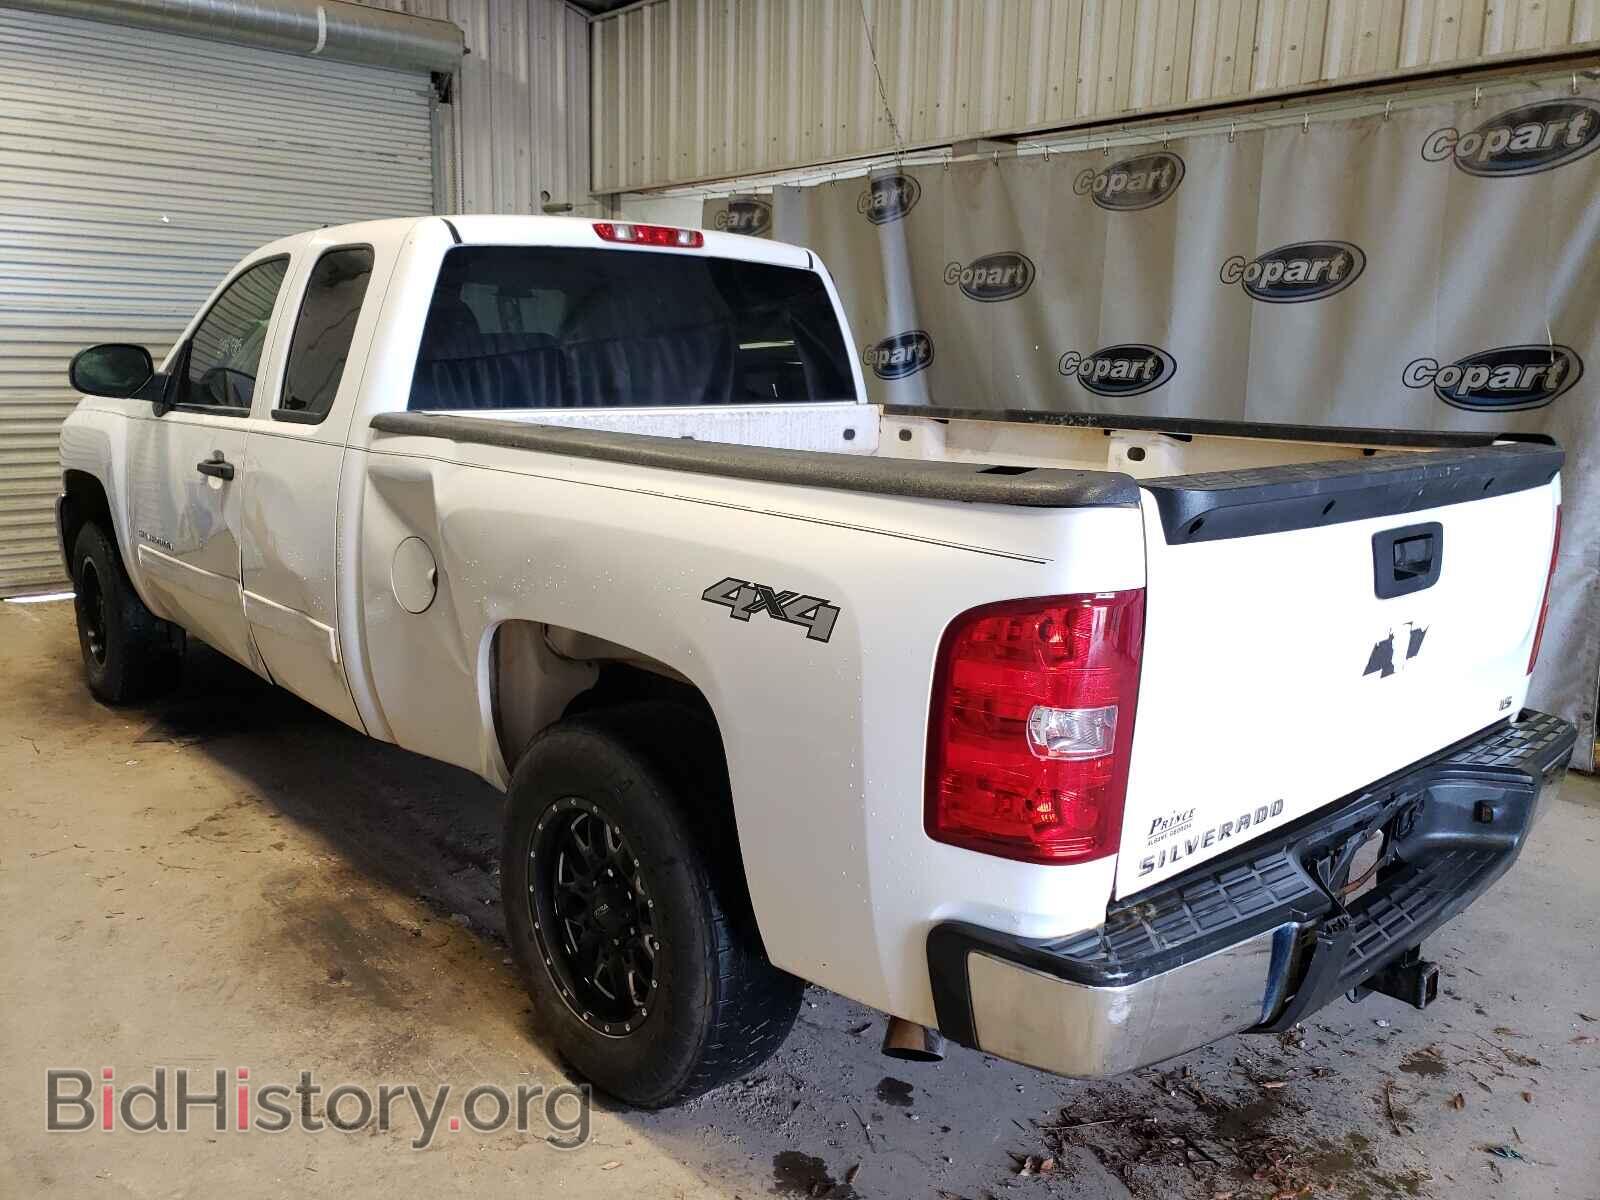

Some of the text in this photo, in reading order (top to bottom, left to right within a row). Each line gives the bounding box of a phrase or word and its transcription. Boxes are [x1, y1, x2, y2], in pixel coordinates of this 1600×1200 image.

[1422, 108, 1593, 163] Copart
[1073, 160, 1171, 199] Copart
[943, 261, 1025, 289] Copart
[1220, 251, 1350, 289] Copart
[1059, 348, 1159, 388] Copart
[1402, 357, 1570, 396] Copart
[1137, 799, 1284, 877] SILVERADO
